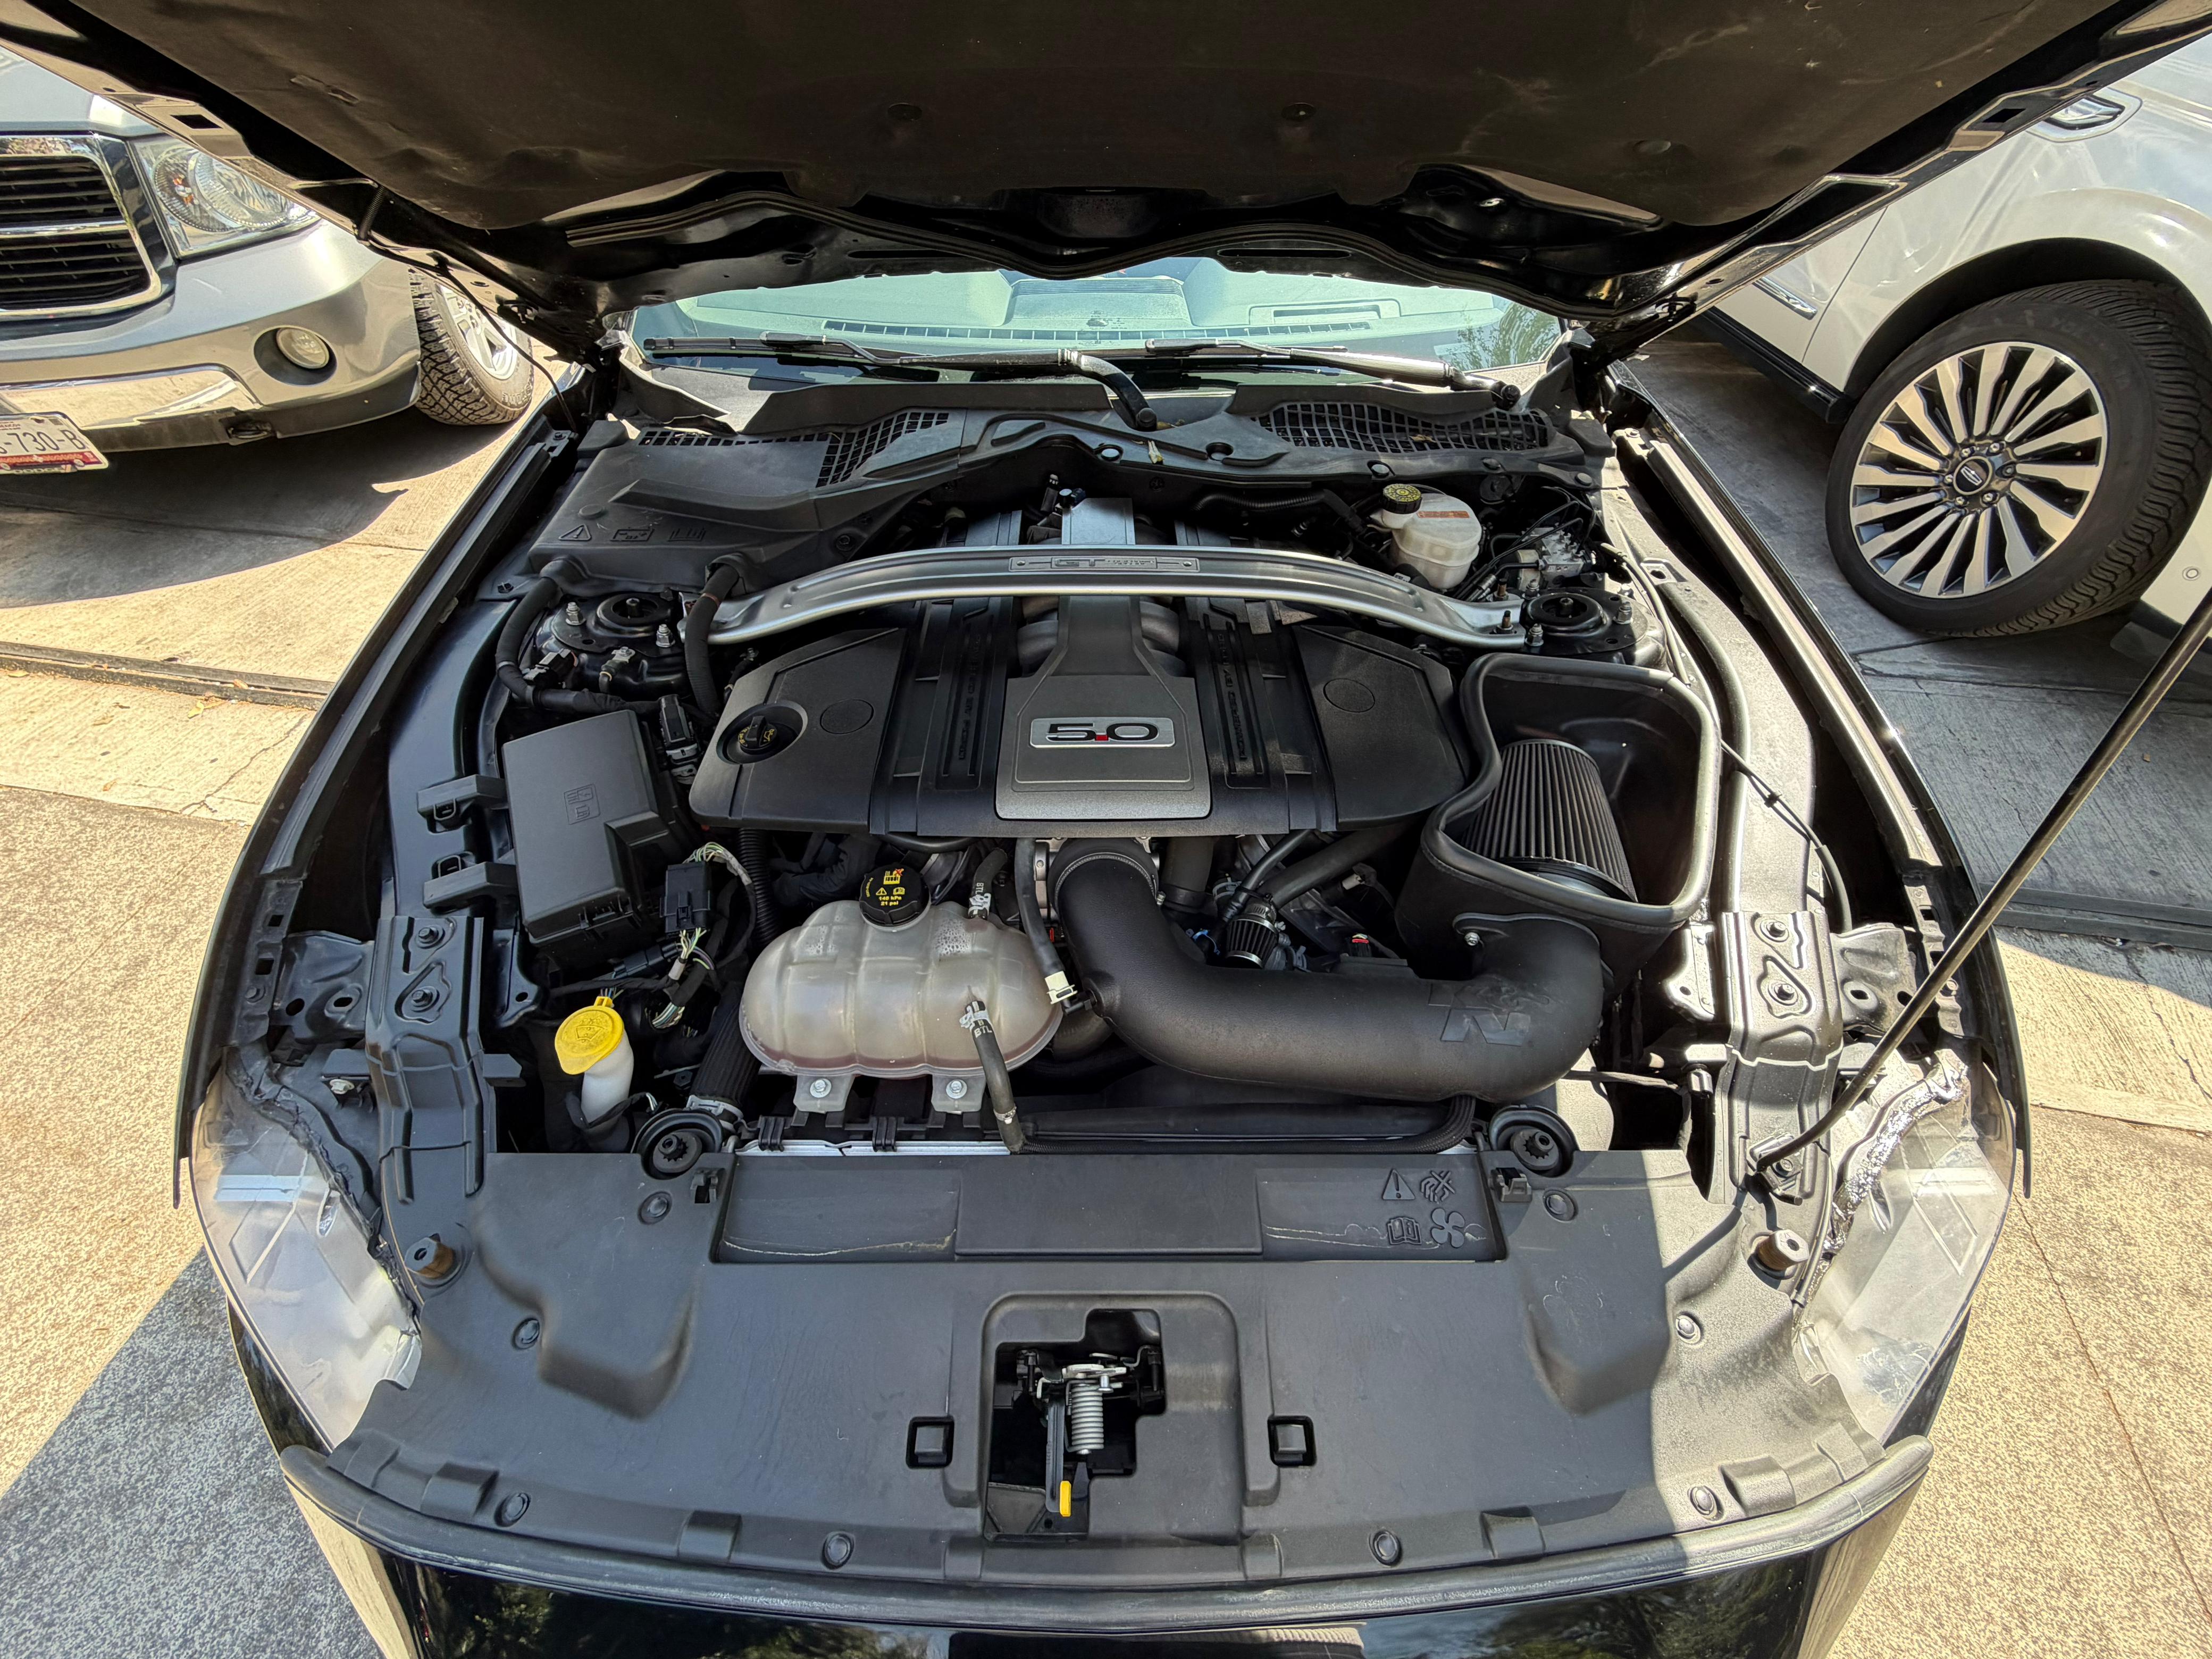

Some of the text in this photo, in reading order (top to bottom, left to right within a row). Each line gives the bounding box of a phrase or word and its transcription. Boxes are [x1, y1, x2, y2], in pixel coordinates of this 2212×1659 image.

[0, 429, 86, 454] -730-B
[1054, 558, 1106, 567] GT
[1046, 723, 1158, 741] 5.0
[974, 1026, 993, 1038] BTL
